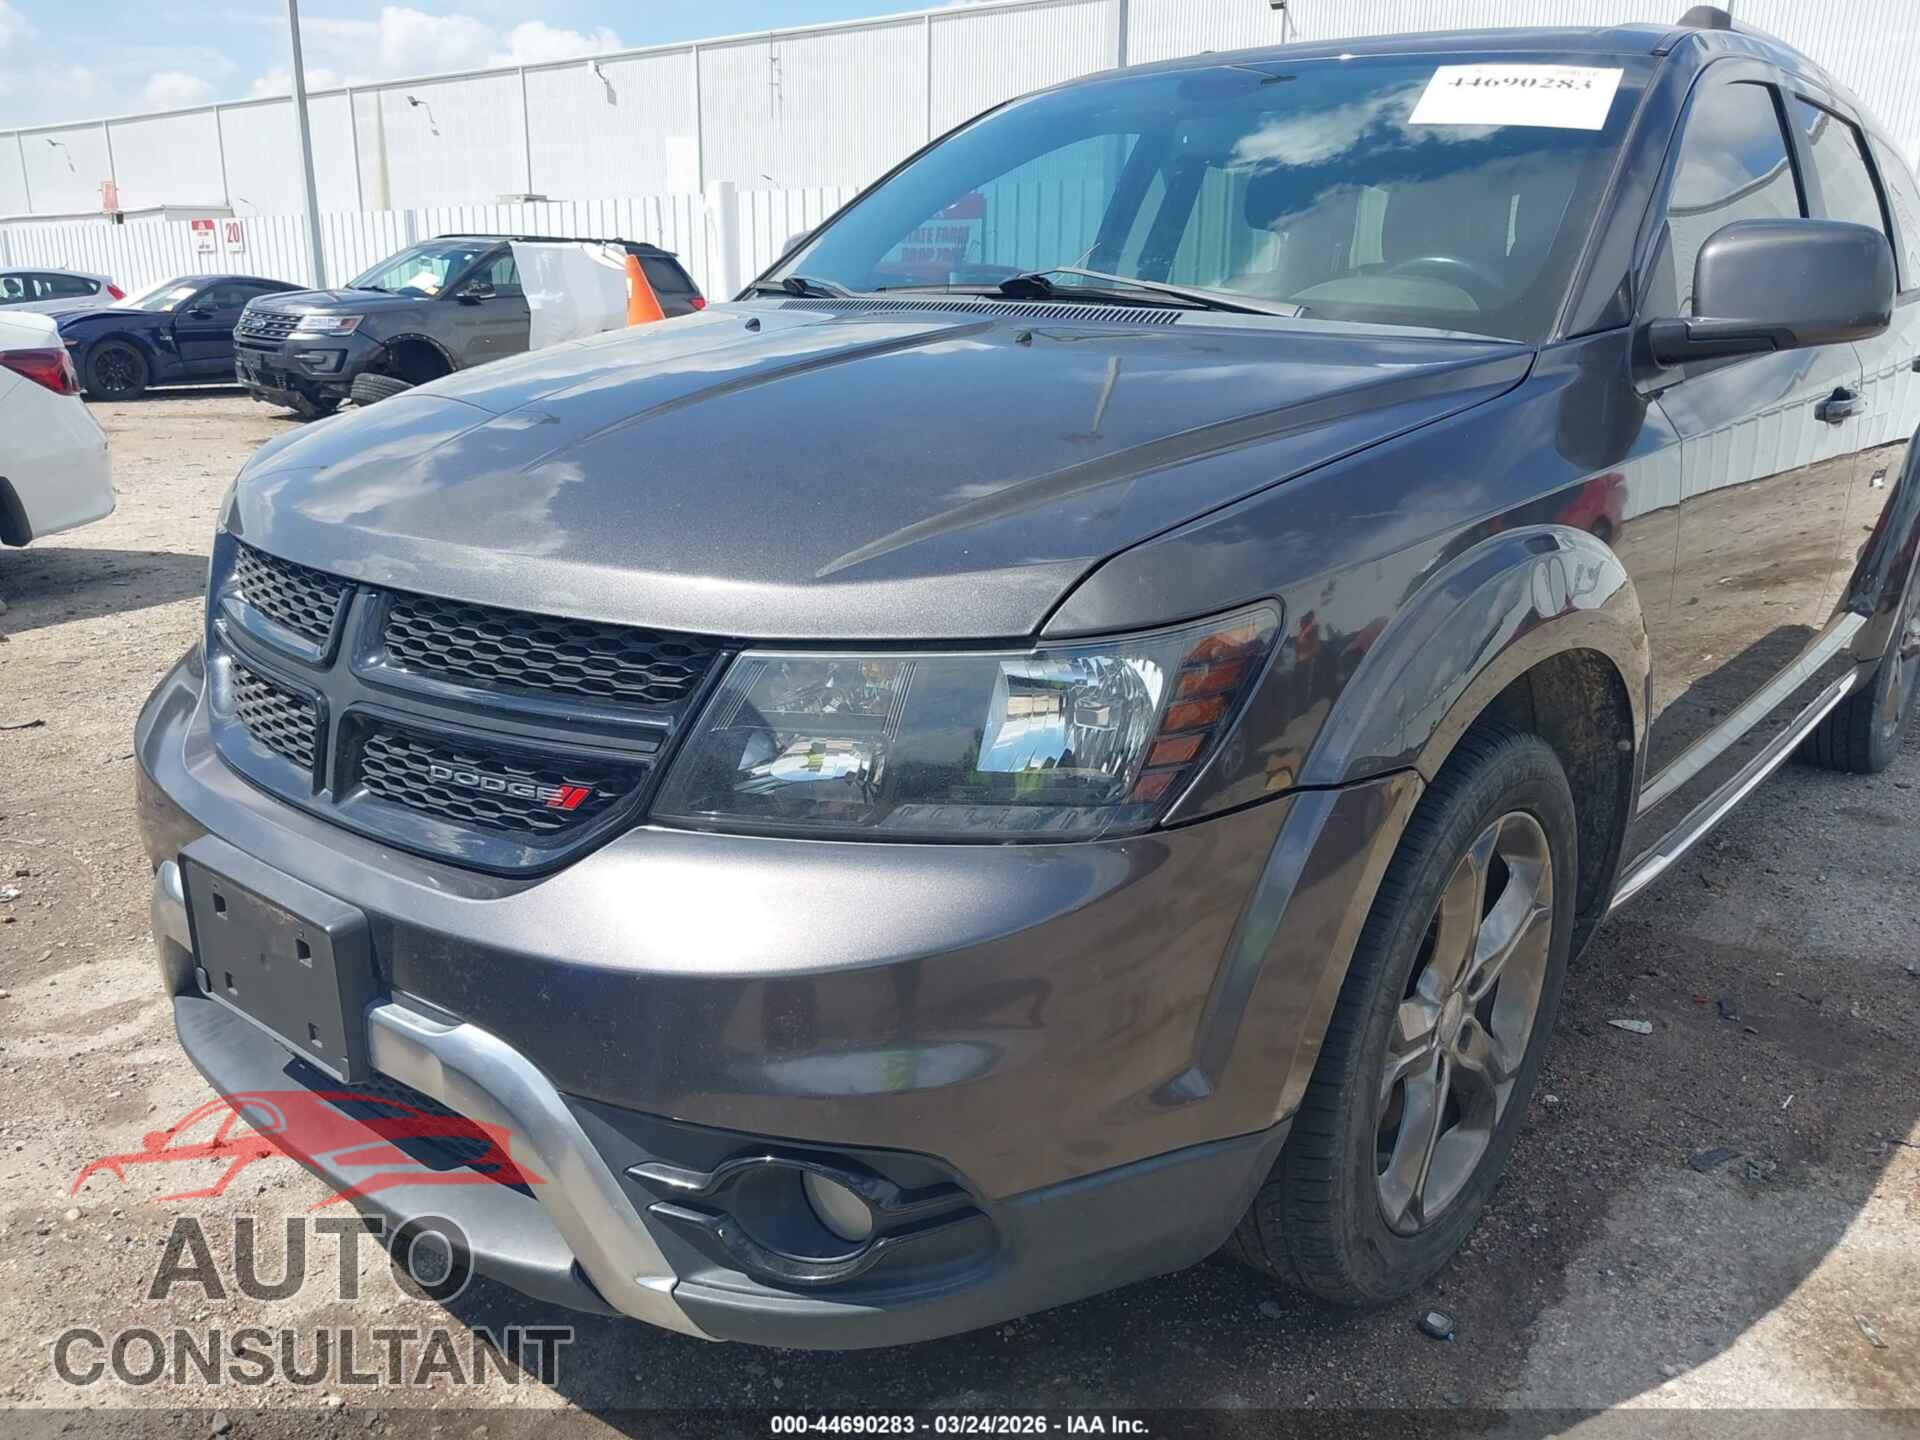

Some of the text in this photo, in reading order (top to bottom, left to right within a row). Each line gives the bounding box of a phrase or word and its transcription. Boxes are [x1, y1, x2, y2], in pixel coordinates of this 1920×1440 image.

[1448, 77, 1593, 91] 44690283
[225, 222, 240, 243] 20
[430, 765, 564, 803] DODGE
